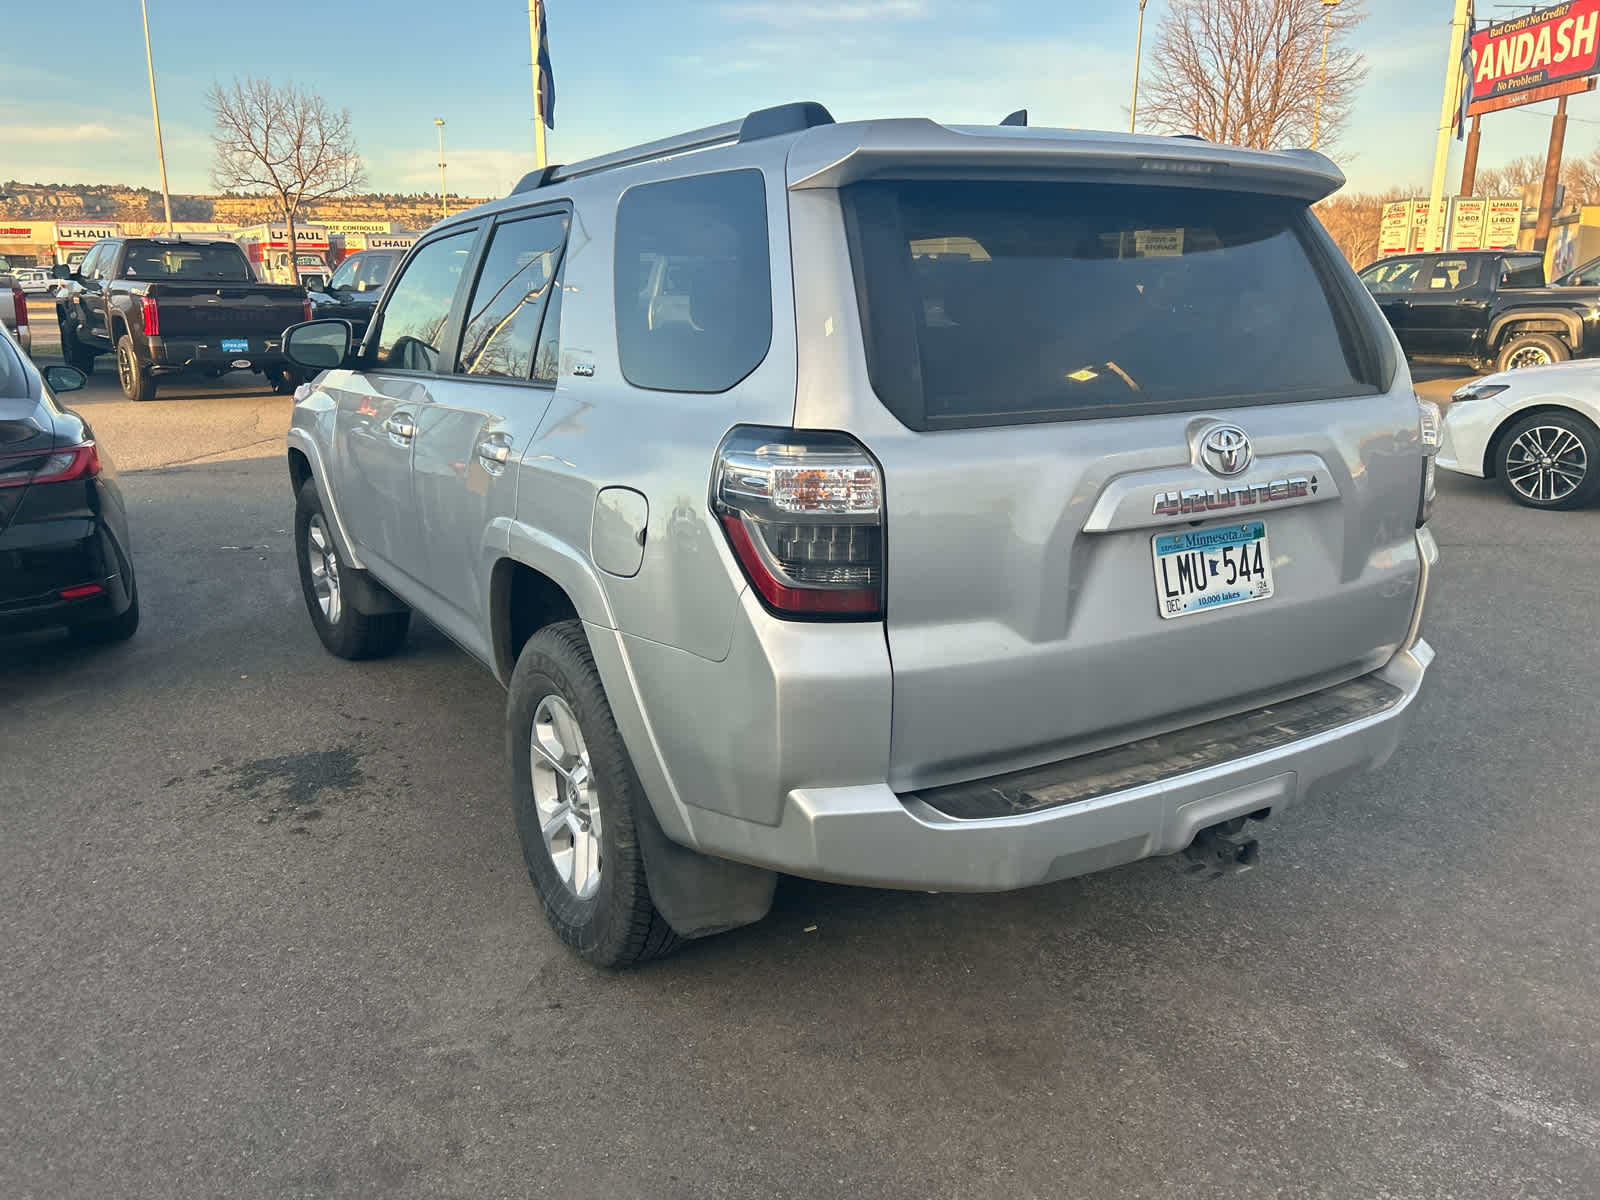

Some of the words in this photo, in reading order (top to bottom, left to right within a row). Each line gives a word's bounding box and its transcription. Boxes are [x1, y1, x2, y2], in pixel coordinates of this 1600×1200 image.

[1490, 28, 1503, 38] Bad
[1504, 18, 1530, 33] Credit?
[1530, 15, 1541, 25] No
[1541, 4, 1570, 21] Credit?
[1497, 82, 1507, 92] No
[1508, 71, 1543, 89] Problem!
[272, 231, 323, 240] U-AUL
[1161, 551, 1208, 597] LMU
[1223, 541, 1265, 585] 544
[1167, 599, 1182, 613] DEC
[1198, 595, 1221, 606] 10,000
[1222, 591, 1241, 601] lakes
